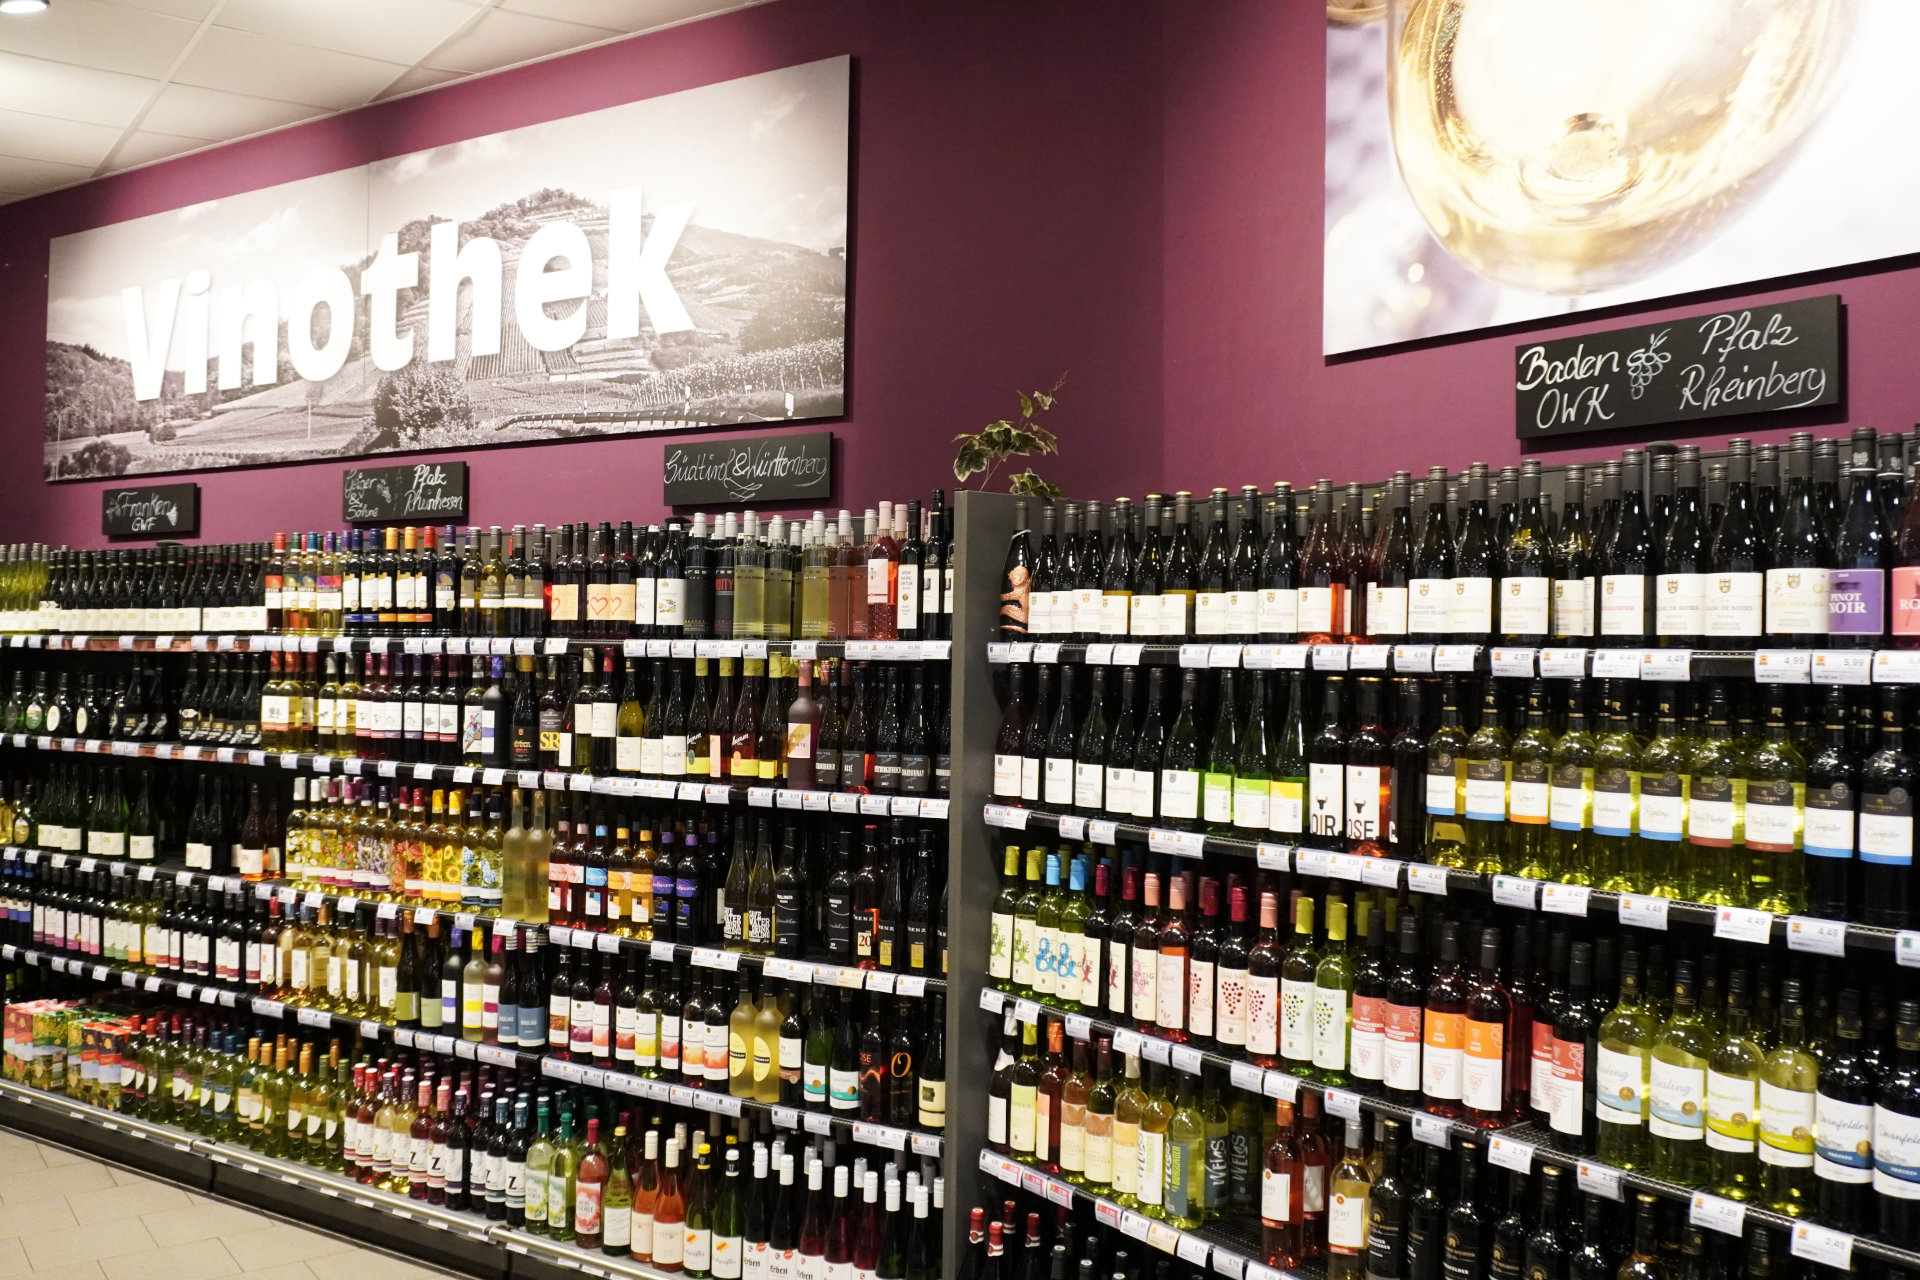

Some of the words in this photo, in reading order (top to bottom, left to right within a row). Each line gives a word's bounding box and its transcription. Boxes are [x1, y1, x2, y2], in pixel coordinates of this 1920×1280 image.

[122, 185, 697, 401] Vinothek
[1699, 311, 1799, 362] Pfalz
[1517, 344, 1620, 391] Baden
[1679, 361, 1827, 411] Rheinberg
[1536, 384, 1616, 429] OWK
[413, 464, 447, 493] Pfalz
[118, 491, 171, 518] Franken
[345, 502, 379, 520] Söhne
[131, 517, 157, 532] GWF
[1830, 593, 1862, 602] PINOT
